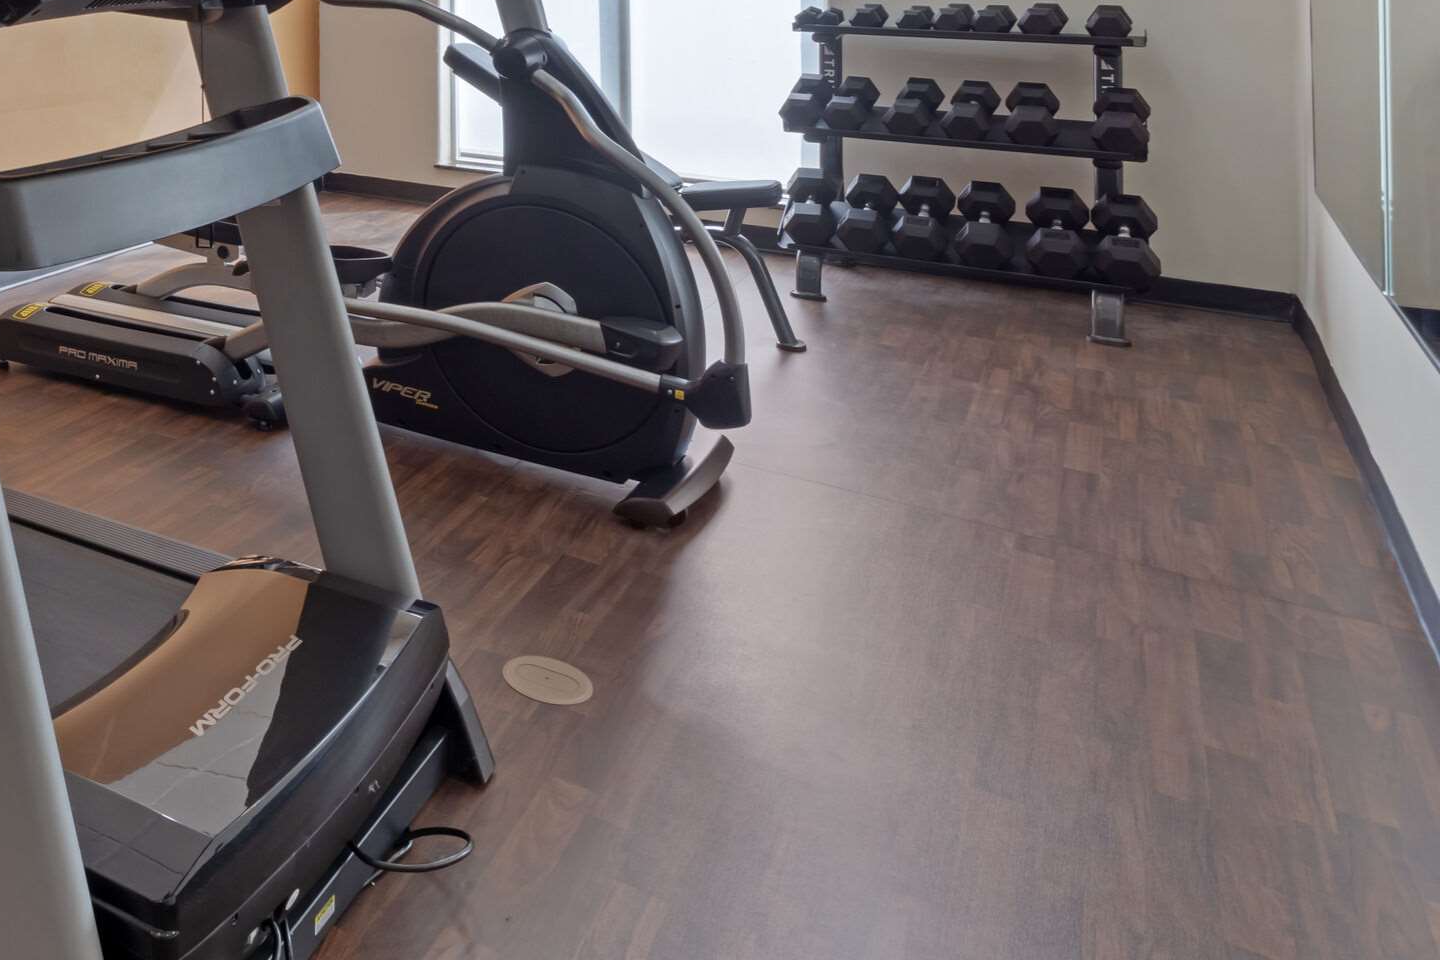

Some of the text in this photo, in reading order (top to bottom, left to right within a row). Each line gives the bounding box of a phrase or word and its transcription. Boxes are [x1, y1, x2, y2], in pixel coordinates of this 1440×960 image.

[58, 345, 138, 371] PRO MAXIMA
[372, 377, 432, 403] VIPER
[189, 634, 303, 737] PRO-FORM
